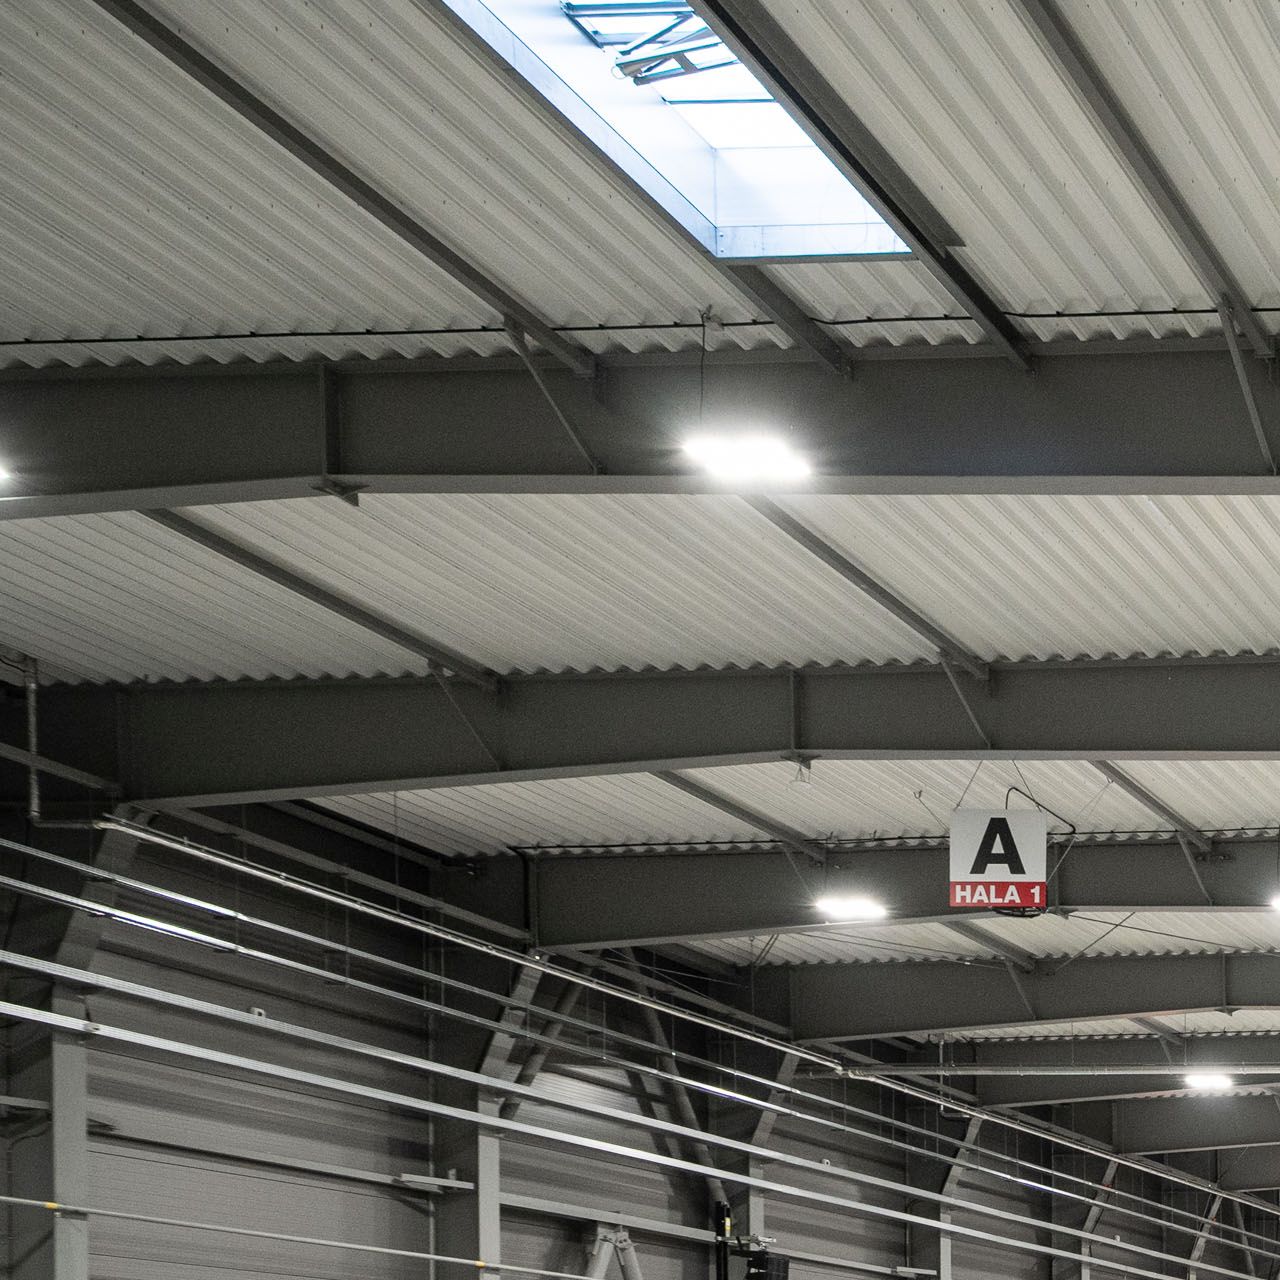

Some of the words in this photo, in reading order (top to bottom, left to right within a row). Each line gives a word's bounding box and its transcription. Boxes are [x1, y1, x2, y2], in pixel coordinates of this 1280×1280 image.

[970, 818, 1026, 874] A
[954, 883, 1024, 905] HALA
[1029, 884, 1041, 904] 1
